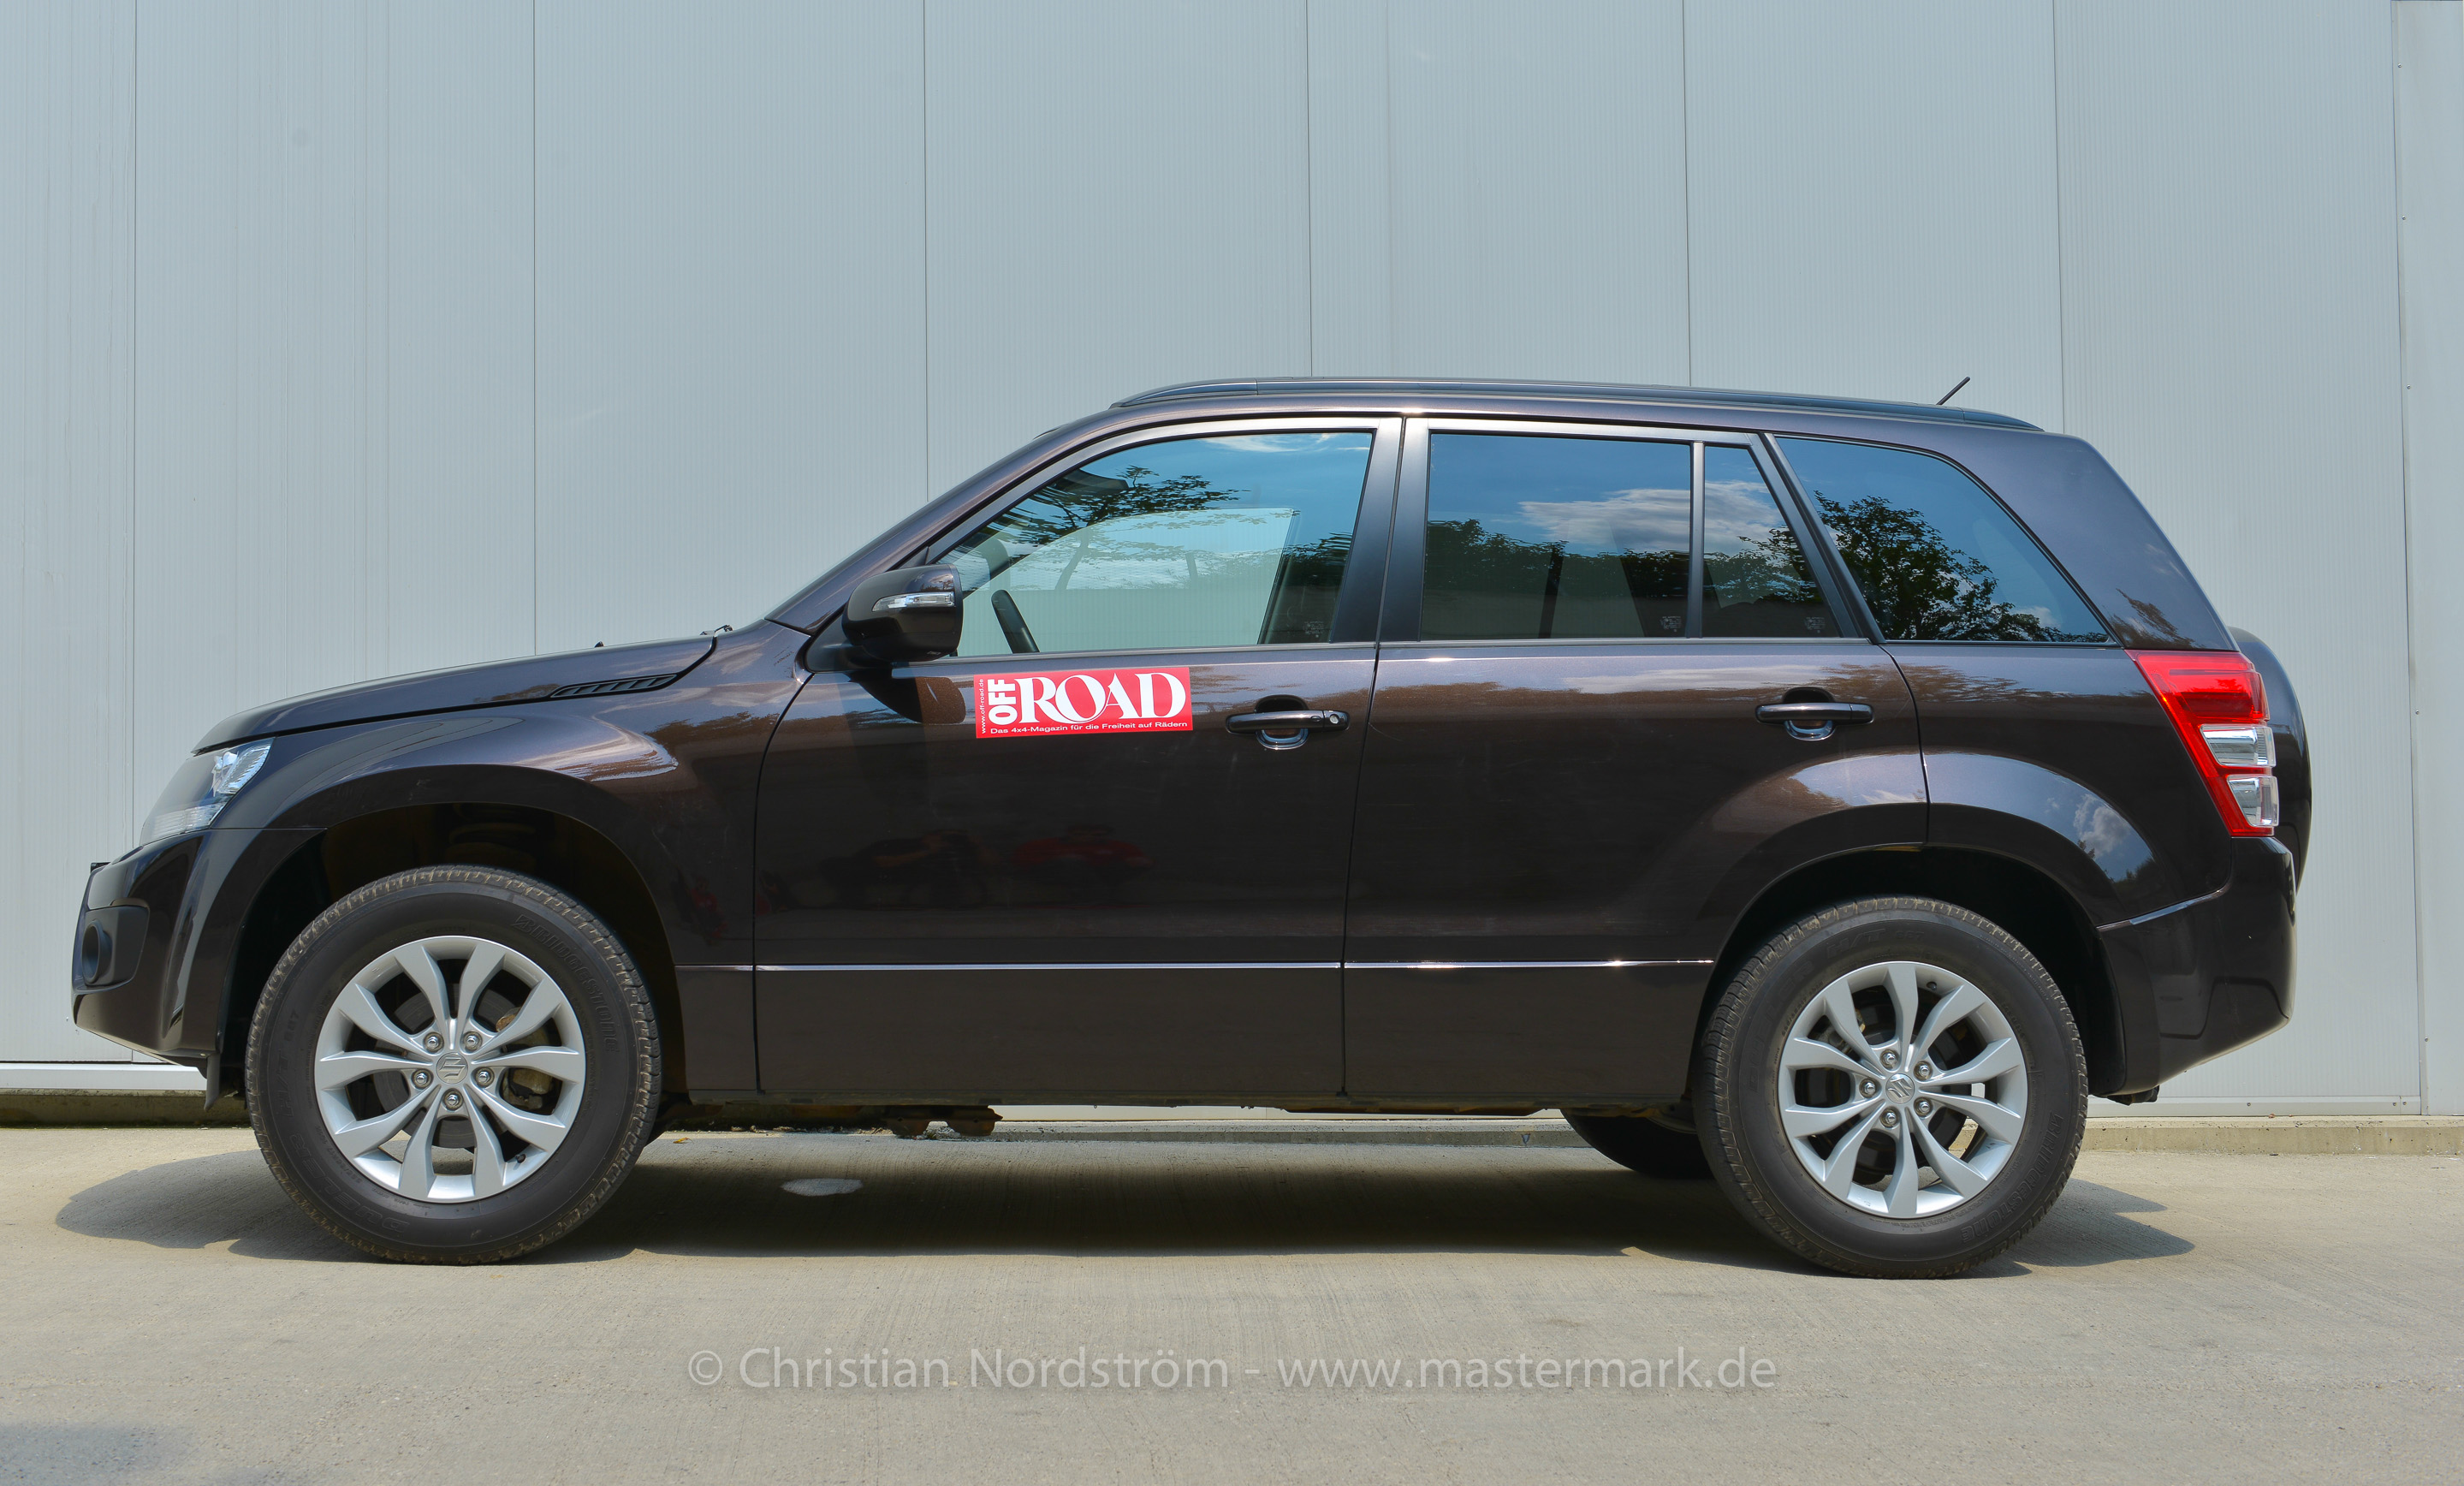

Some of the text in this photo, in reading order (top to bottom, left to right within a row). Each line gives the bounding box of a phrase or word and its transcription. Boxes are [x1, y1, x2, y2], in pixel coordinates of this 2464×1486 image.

[988, 672, 1186, 725] OFF ROAD
[1011, 724, 1068, 733] 4x4-Magazin
[1961, 1110, 2064, 1245] BRIDGESTONE
